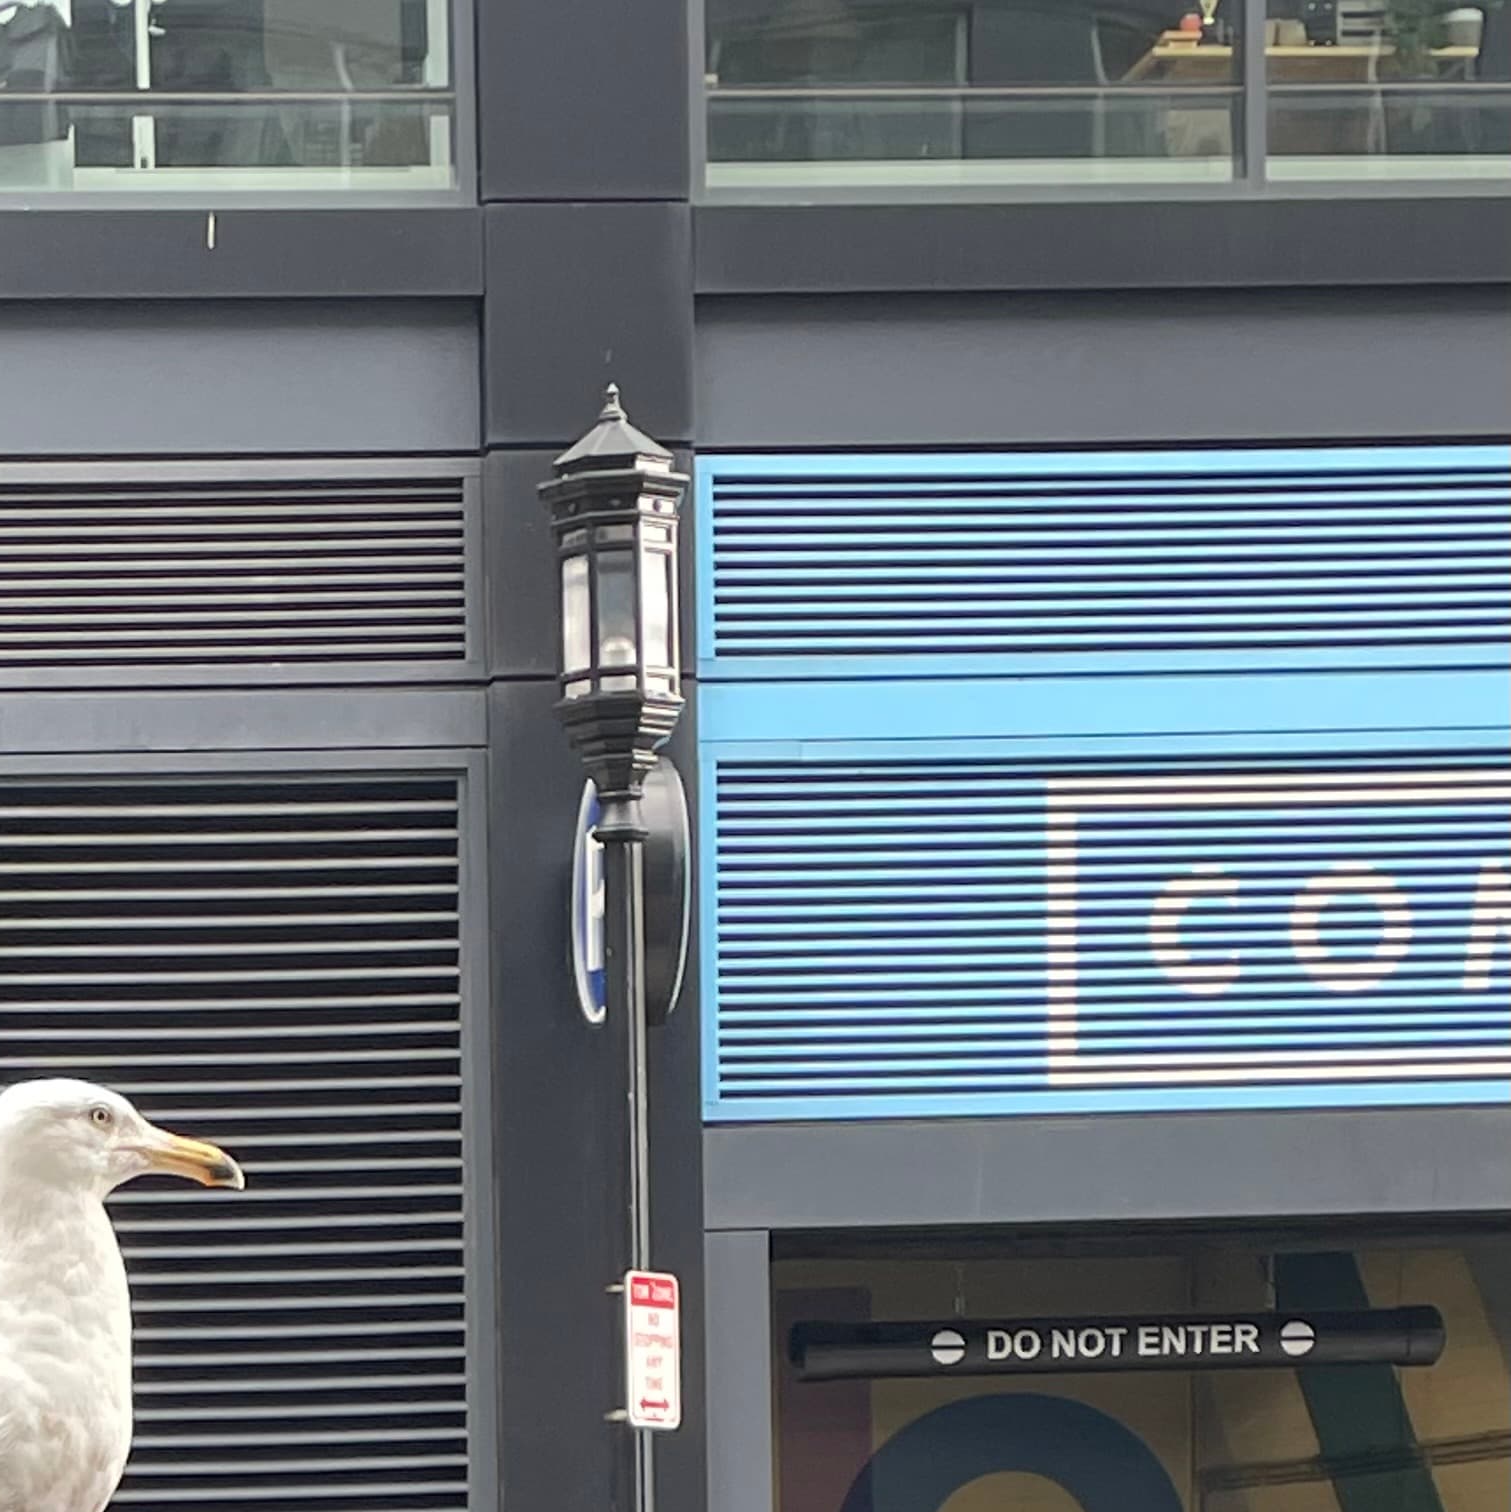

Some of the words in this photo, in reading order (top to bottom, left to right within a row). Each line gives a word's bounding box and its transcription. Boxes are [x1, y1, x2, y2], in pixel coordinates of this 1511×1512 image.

[987, 1329, 1041, 1360] DO
[1051, 1327, 1128, 1358] NOT
[1137, 1323, 1261, 1356] ENTER
